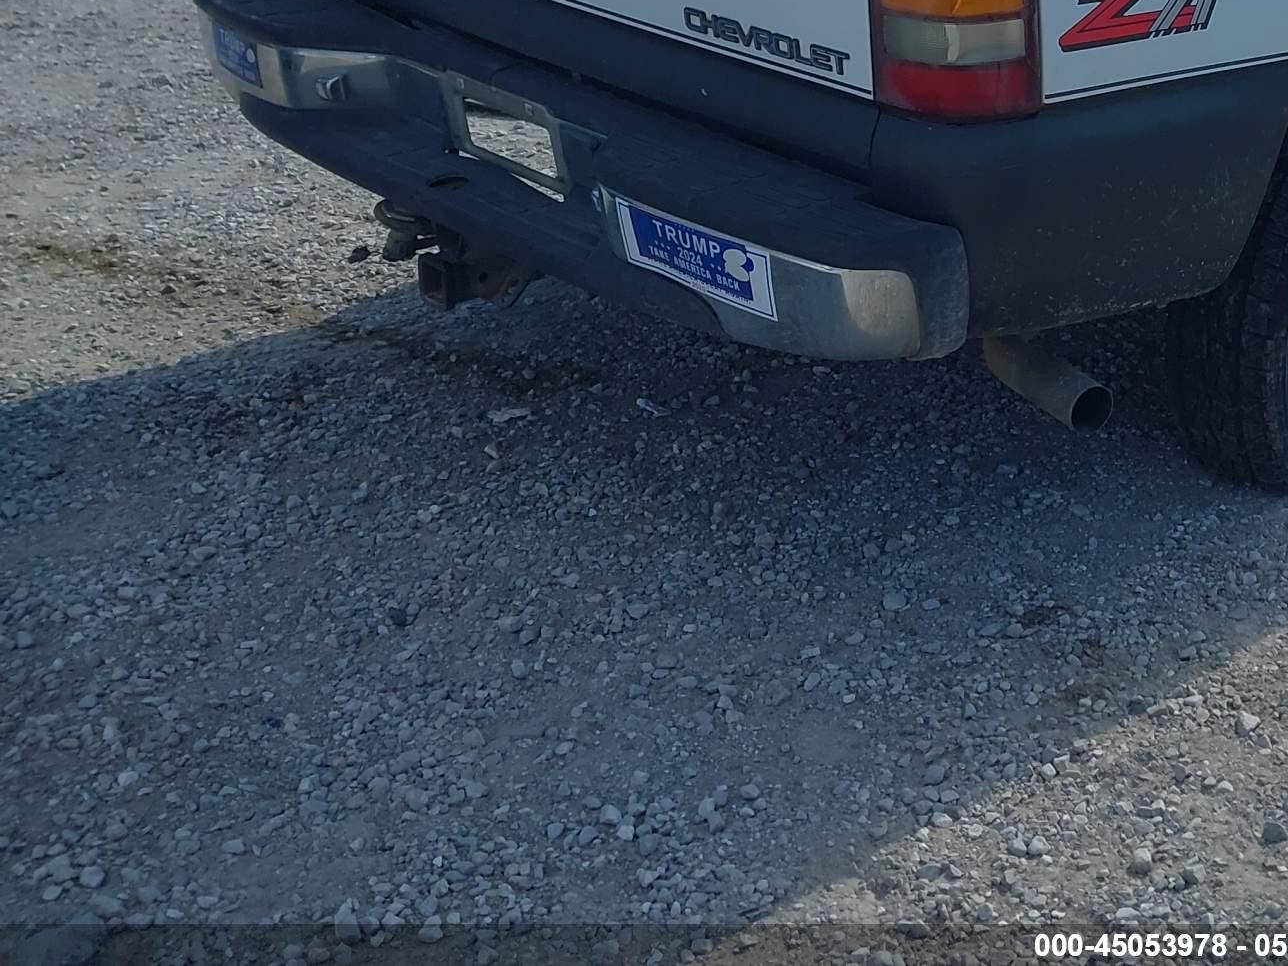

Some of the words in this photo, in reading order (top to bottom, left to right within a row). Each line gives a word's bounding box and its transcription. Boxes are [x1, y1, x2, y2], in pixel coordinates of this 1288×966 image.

[683, 6, 850, 76] CHEVROLET
[652, 220, 720, 258] TRUMP
[677, 246, 703, 267] 2024
[648, 245, 670, 262] TAKE
[673, 255, 712, 280] AMERICA
[716, 273, 741, 292] BACK
